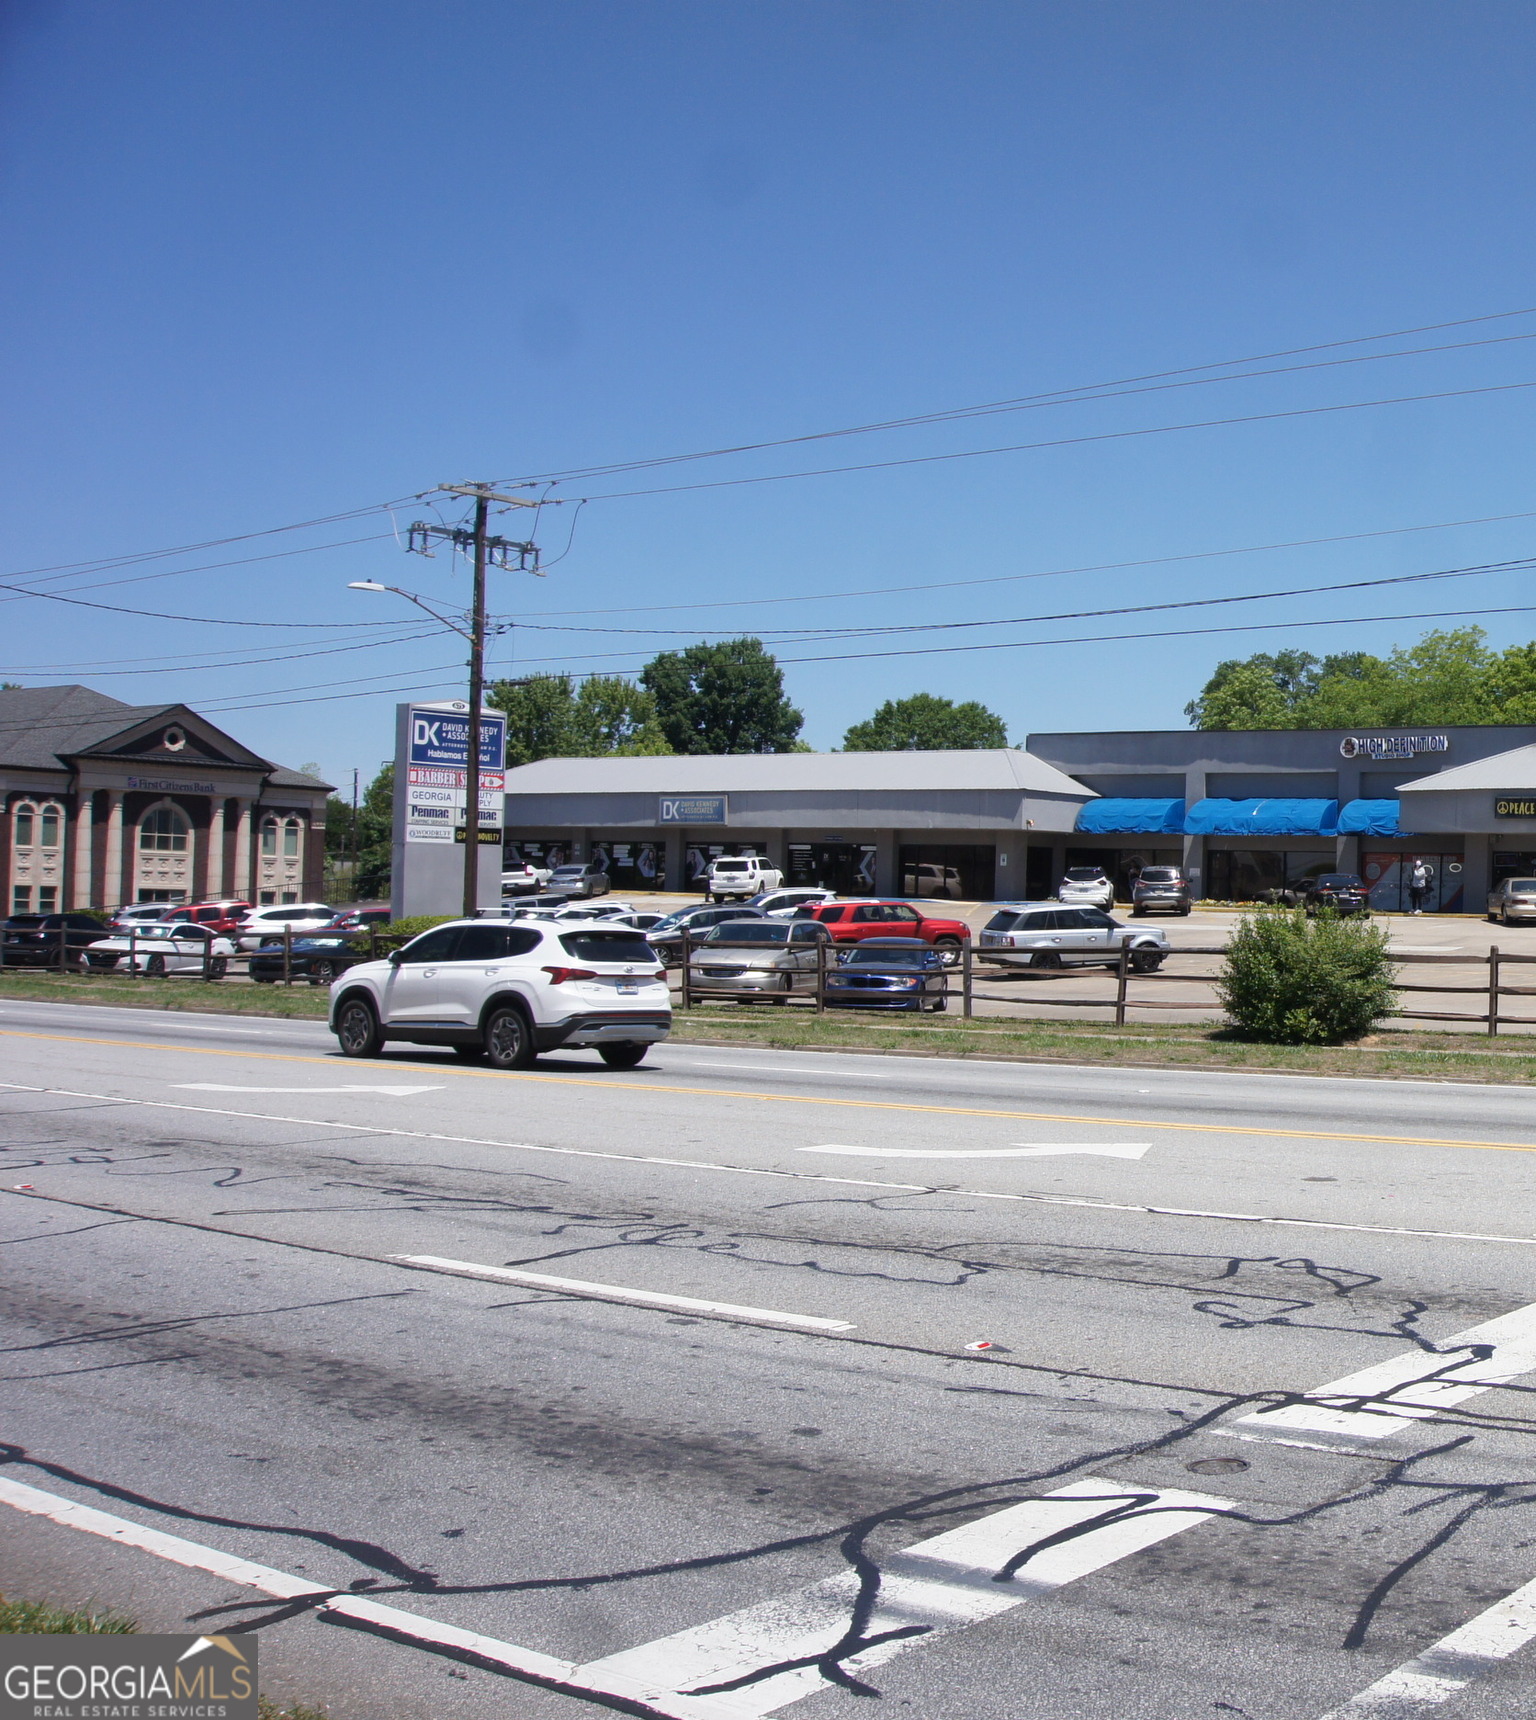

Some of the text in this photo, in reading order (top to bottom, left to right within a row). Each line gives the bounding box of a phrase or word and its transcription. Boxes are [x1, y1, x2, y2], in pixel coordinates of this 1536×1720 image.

[414, 720, 440, 746] DK
[442, 722, 498, 735] DAVID KNEDY
[1358, 735, 1448, 754] HIGH DEFINITION
[428, 749, 491, 762] Hablamos Eñol
[417, 770, 486, 786] BARBER SP
[412, 790, 452, 801] GEORGIA
[411, 805, 497, 821] Penmac Pmac
[663, 801, 679, 819] DK
[1509, 802, 1535, 815] PEACE
